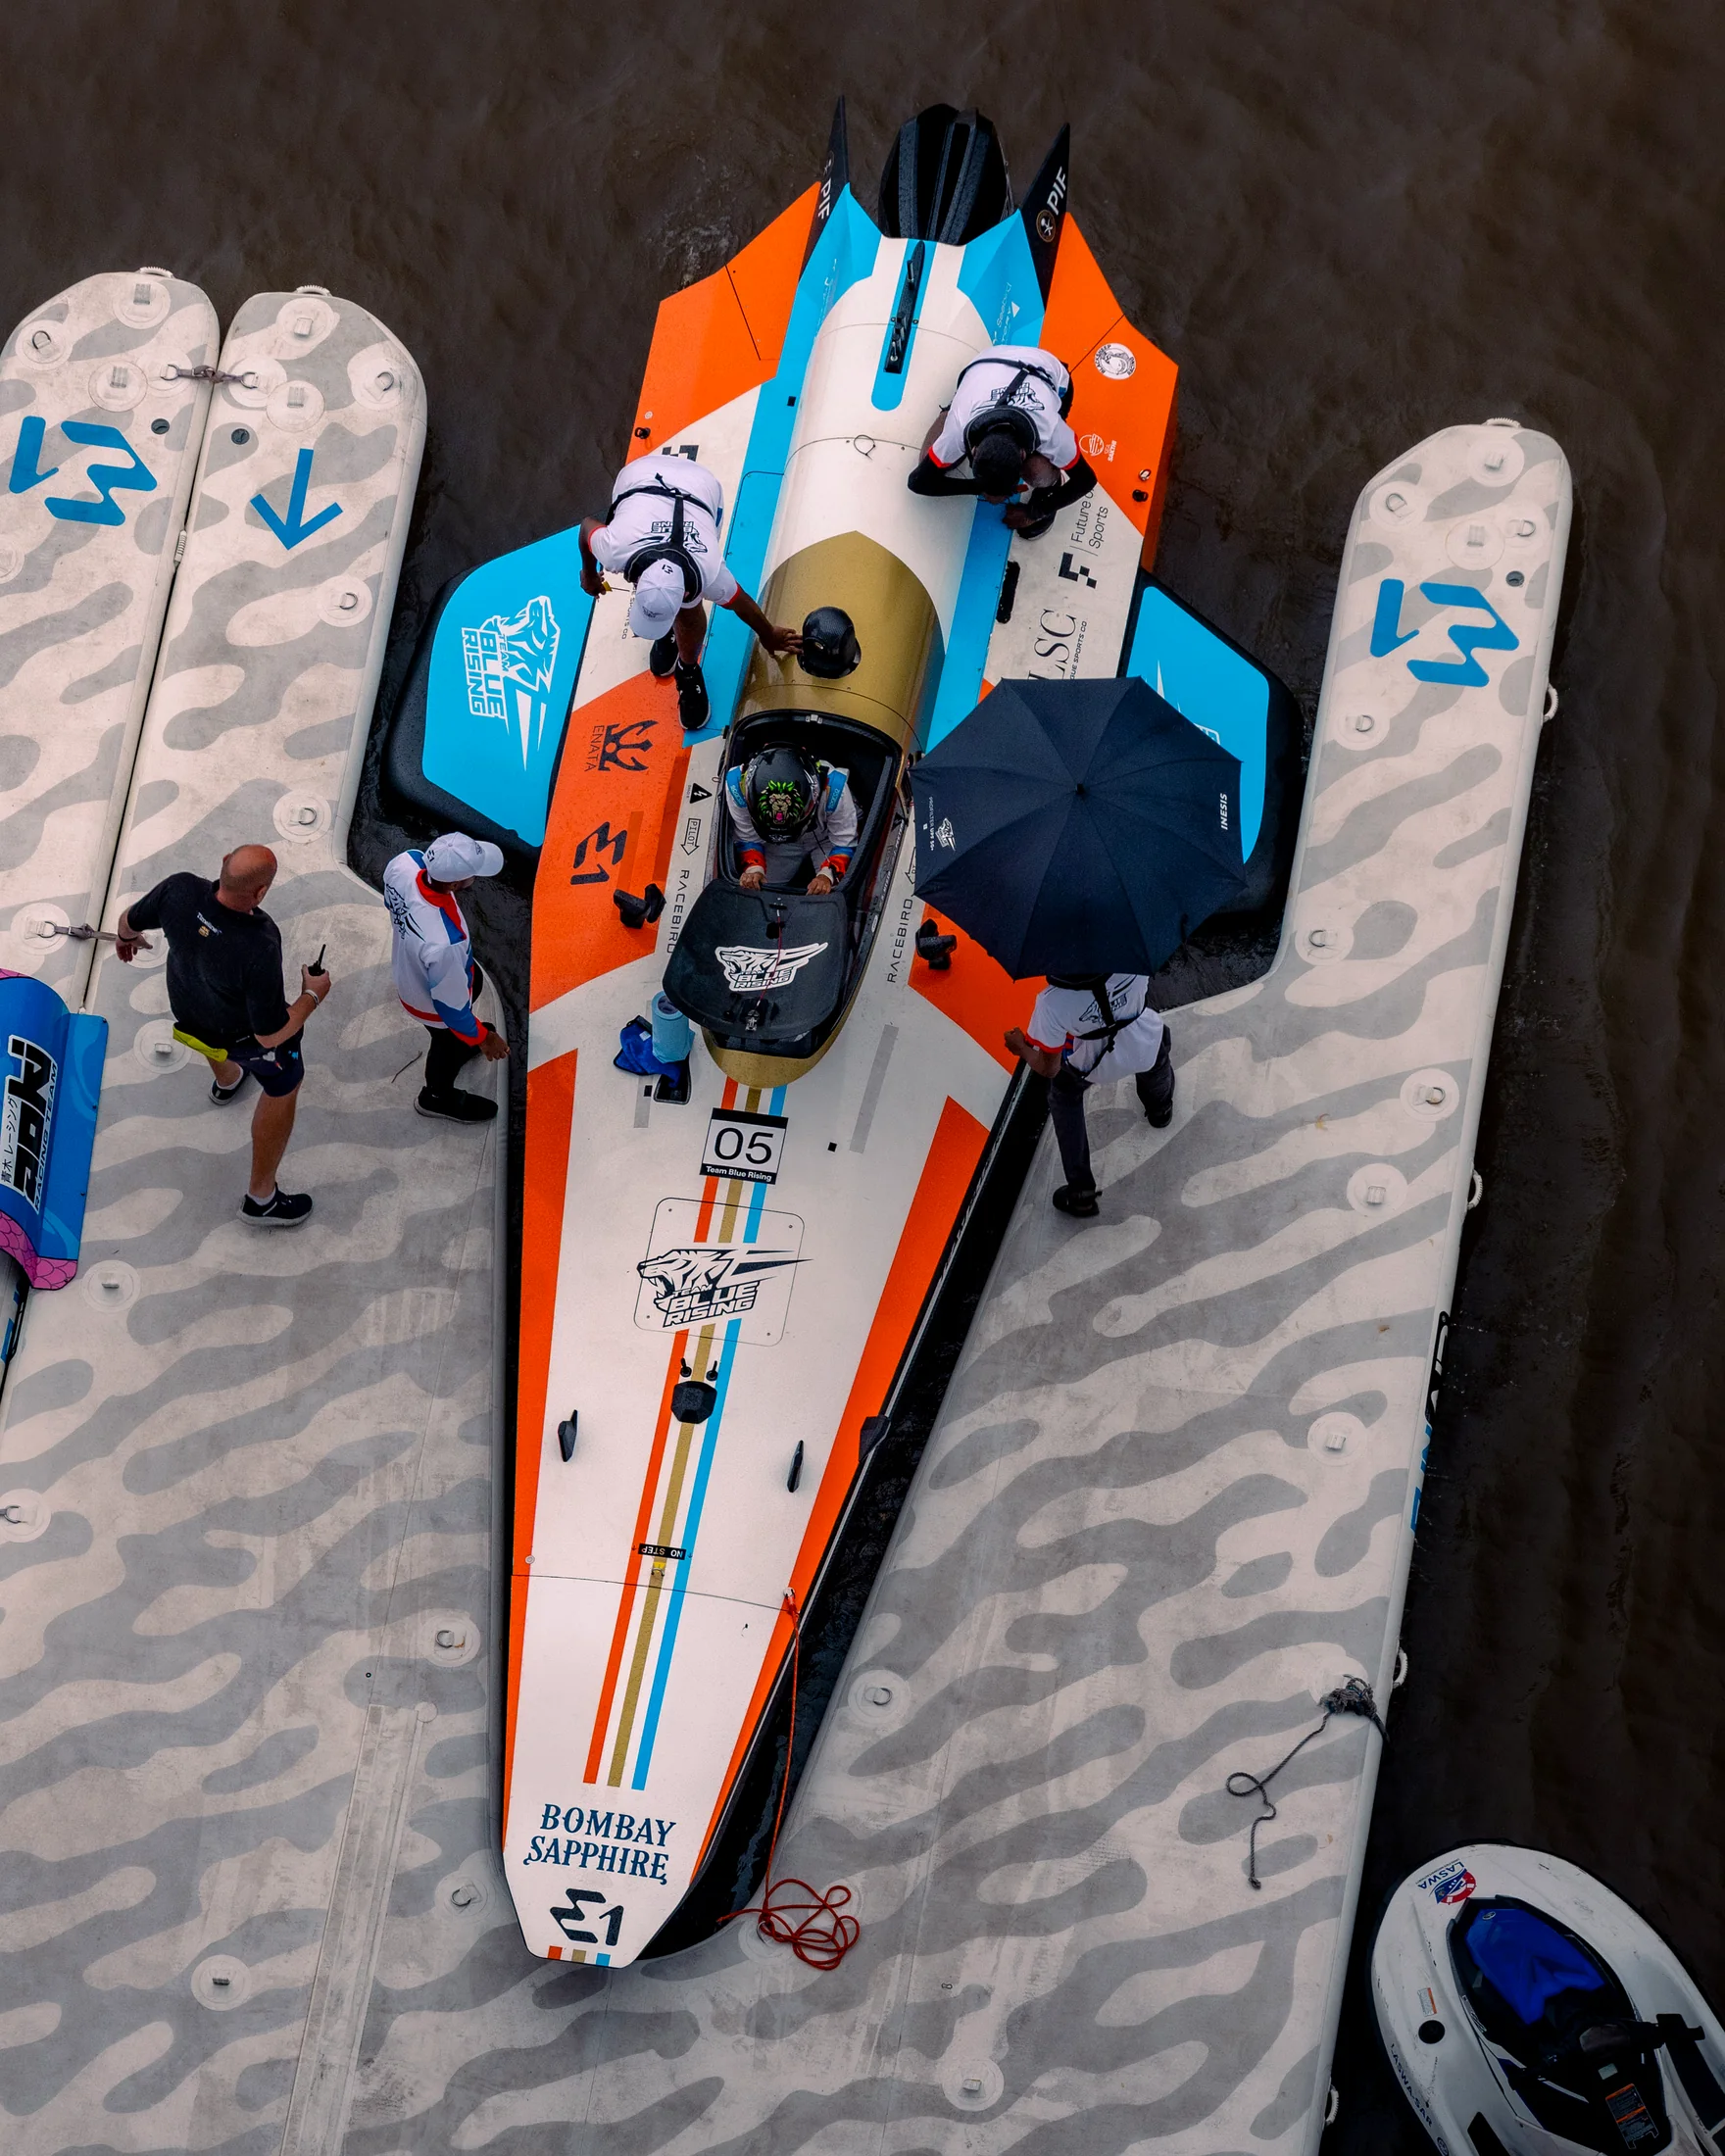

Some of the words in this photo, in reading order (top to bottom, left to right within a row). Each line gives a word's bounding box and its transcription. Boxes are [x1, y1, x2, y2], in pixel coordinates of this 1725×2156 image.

[818, 177, 831, 220] PIF
[1047, 166, 1066, 216] PIF
[1071, 500, 1091, 543] Future
[1089, 505, 1109, 549] Sports
[498, 634, 510, 672] TEAM
[622, 626, 629, 639] CO
[1073, 633, 1084, 663] SPORTS
[1081, 620, 1087, 633] CO
[464, 630, 486, 715] RISING
[479, 631, 506, 718] BLUE
[584, 725, 605, 772] ENATA
[1220, 792, 1228, 831] INESIS
[687, 820, 698, 846] PILOT
[667, 869, 689, 954] RACEBIRD
[887, 898, 913, 983] RACEBIRD
[735, 978, 789, 988] RISING
[738, 967, 792, 981] BLUE
[4, 1096, 18, 1155] レーシング
[35, 1132, 49, 1211] RACING
[46, 1063, 57, 1124] TEAM
[715, 1127, 773, 1164] 05
[706, 1165, 727, 1175] Team
[728, 1169, 746, 1177] Blue
[747, 1172, 772, 1182] Rising
[668, 1281, 760, 1313] BLUE
[674, 1284, 713, 1296] TEAM
[664, 1296, 754, 1326] RISING
[641, 1546, 665, 1555] STEP
[670, 1549, 684, 1558] NO
[540, 1804, 676, 1847] BOMBAY
[523, 1836, 669, 1885] SAPPHIRE
[1418, 1862, 1465, 1889] LASWA
